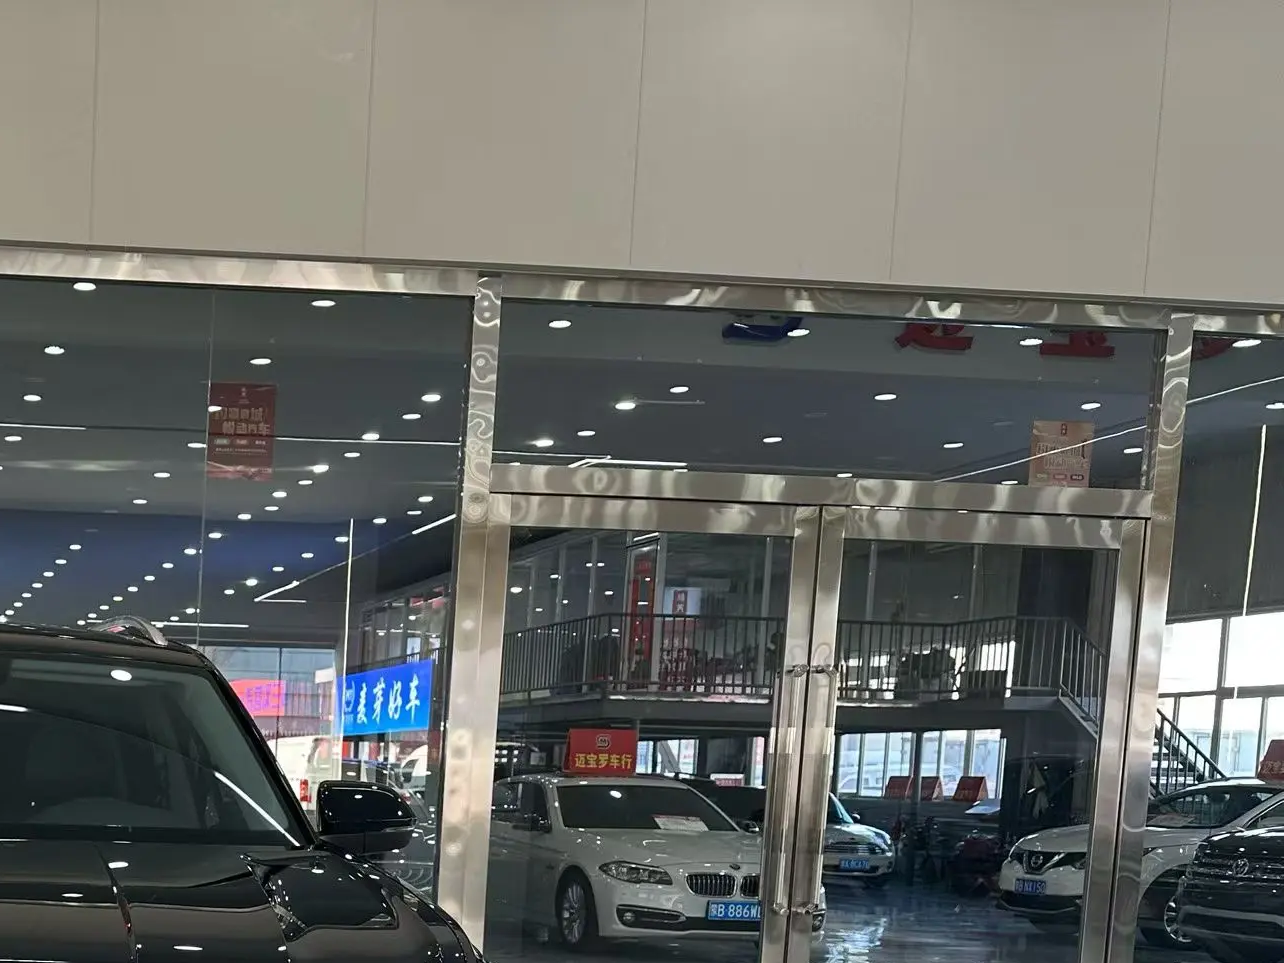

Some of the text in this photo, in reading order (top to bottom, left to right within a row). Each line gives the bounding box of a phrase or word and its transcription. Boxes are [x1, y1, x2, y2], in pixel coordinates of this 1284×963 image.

[574, 753, 633, 769] 迈宝罗车行
